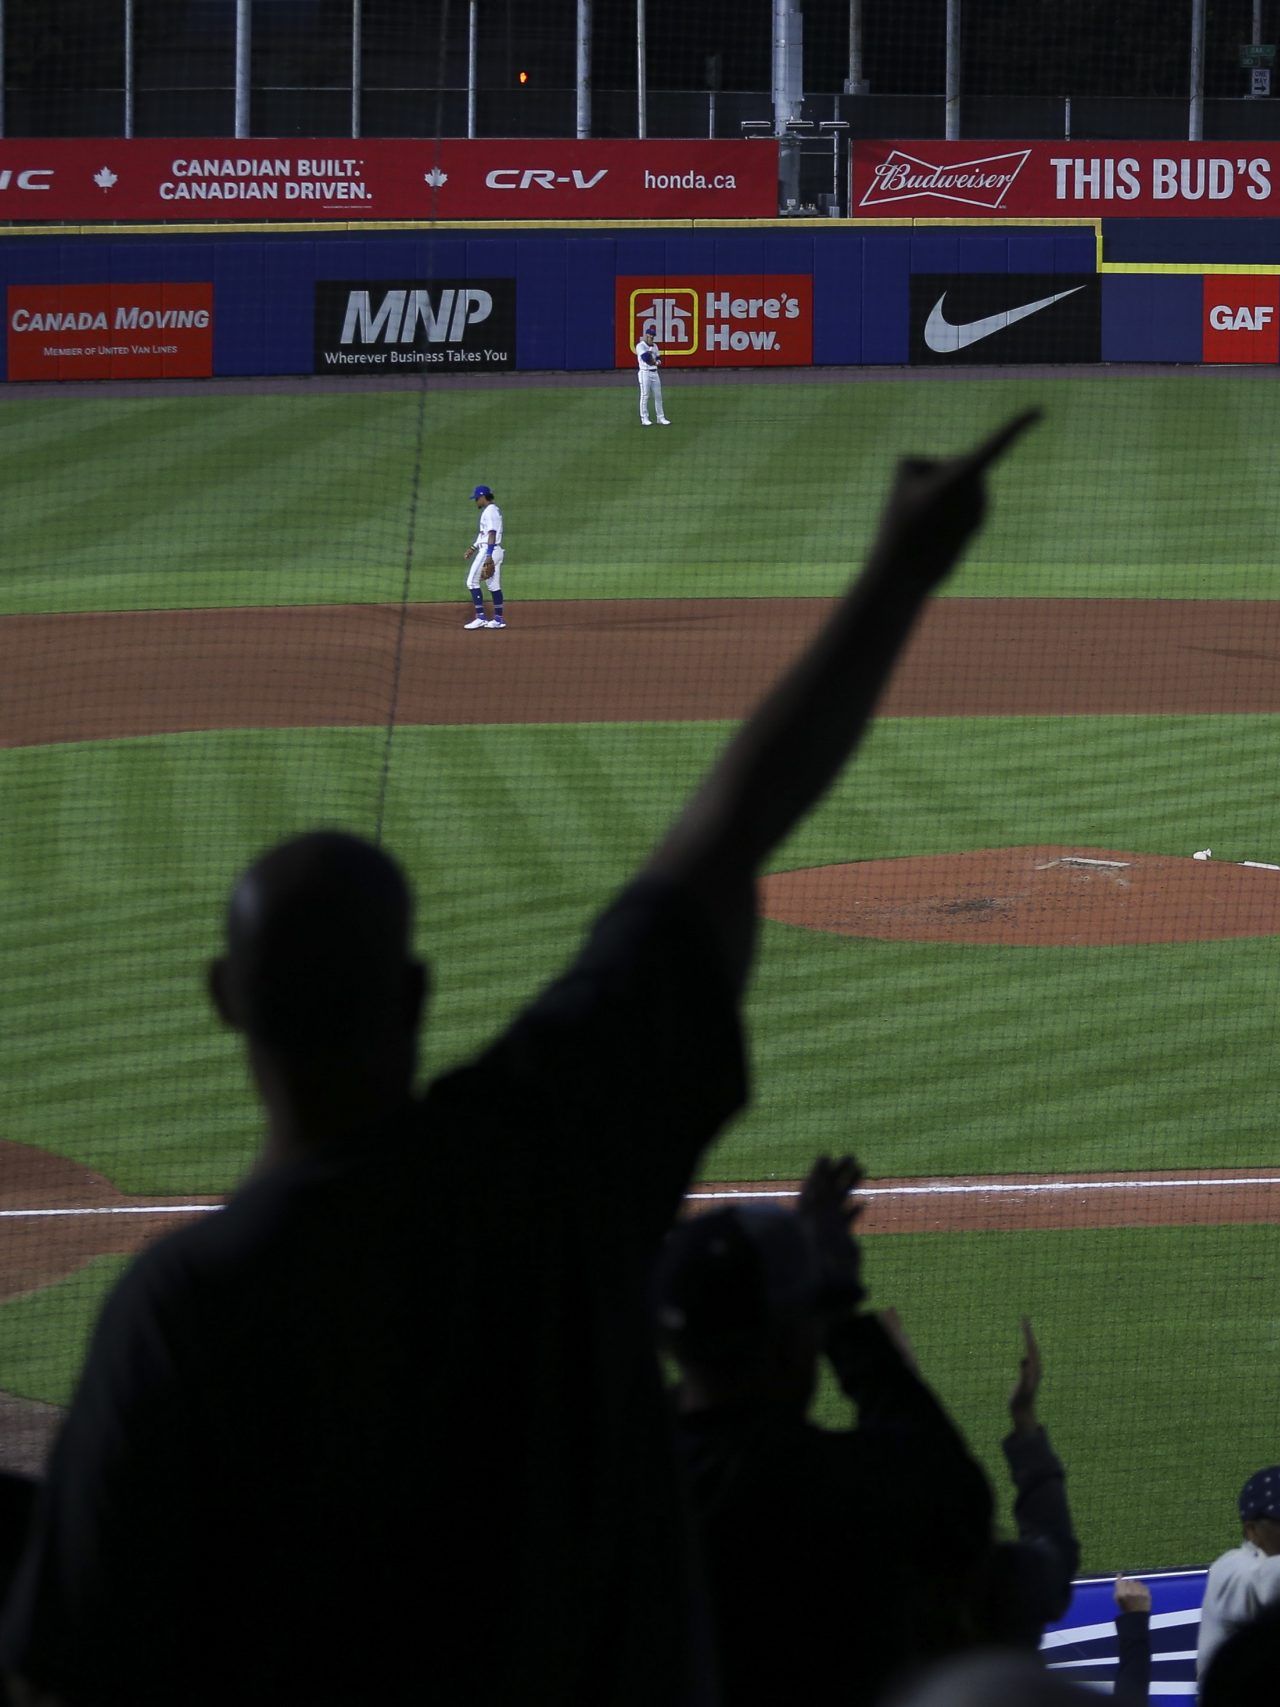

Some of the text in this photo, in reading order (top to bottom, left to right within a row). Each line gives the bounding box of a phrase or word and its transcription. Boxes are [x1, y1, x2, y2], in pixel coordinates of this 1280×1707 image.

[172, 159, 290, 177] CANADIAN
[485, 169, 609, 189] CR-V
[644, 169, 737, 189] honda.ca
[874, 162, 1012, 191] Budweiser
[1051, 158, 1140, 200] THIS
[1152, 158, 1271, 200] BUD'S
[159, 182, 373, 200] CANADIAN DRIVEN.
[340, 289, 493, 344] MNP
[706, 292, 800, 319] Here's
[1209, 305, 1274, 331] GAF
[706, 324, 780, 351] How.
[325, 349, 507, 364] Wherever Business Takes You
